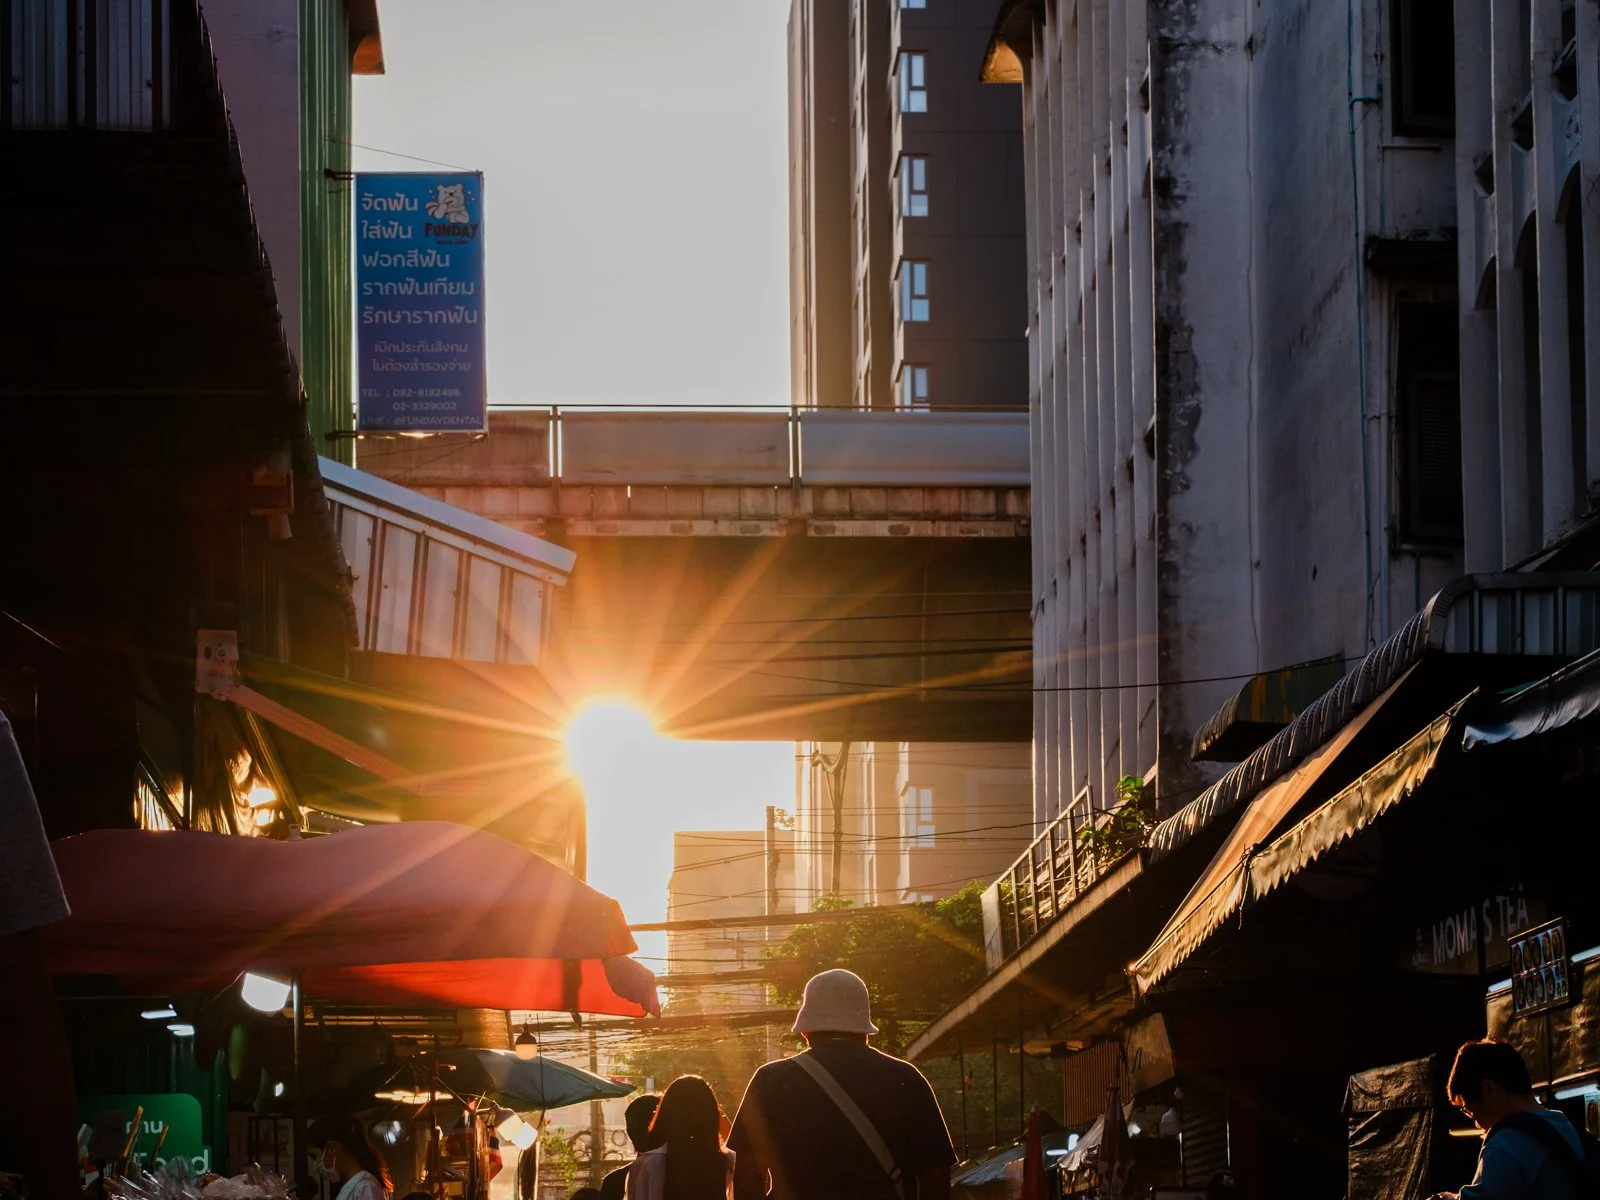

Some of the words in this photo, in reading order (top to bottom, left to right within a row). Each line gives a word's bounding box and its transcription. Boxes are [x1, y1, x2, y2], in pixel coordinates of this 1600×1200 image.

[361, 192, 418, 211] จัดฟัน
[361, 219, 413, 239] ใส่ฟัน
[424, 223, 479, 239] FUNDAY
[362, 248, 450, 267] ฟอกสีฟัน
[362, 276, 474, 296] รากฟันเทียม
[362, 305, 478, 324] รักษารากฟัน
